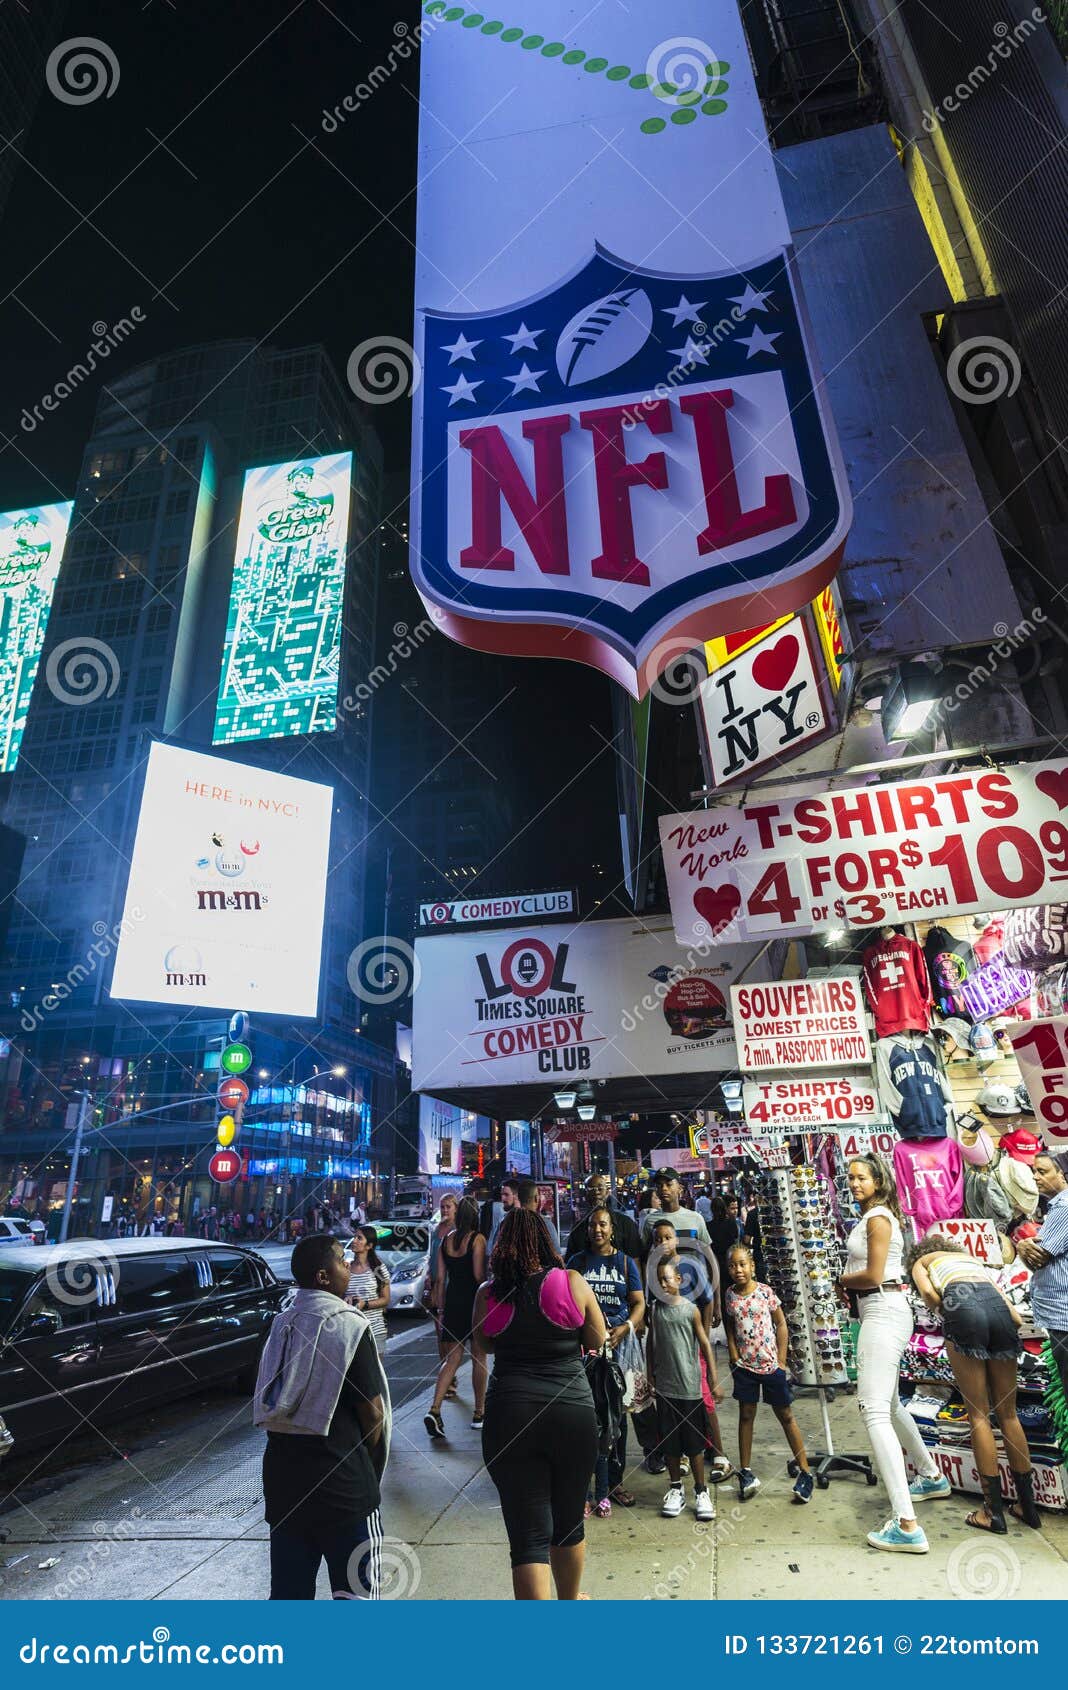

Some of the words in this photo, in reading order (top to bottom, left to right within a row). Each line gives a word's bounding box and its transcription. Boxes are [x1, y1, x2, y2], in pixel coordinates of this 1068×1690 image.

[459, 388, 798, 587] NFL
[262, 503, 332, 526] Green
[268, 518, 334, 542] Giant
[716, 670, 744, 724] I
[717, 680, 808, 776] NY
[184, 780, 233, 803] HERE
[239, 793, 253, 808] in
[258, 798, 299, 818] NYC!
[744, 773, 1019, 850] T-SHIRTS
[668, 822, 730, 850] New
[679, 836, 750, 882] York
[747, 861, 802, 924] 4
[806, 848, 906, 897] FOR
[422, 902, 456, 926] LOL
[811, 904, 828, 921] or
[896, 887, 949, 911] EACH
[476, 937, 577, 1001] LOL
[738, 980, 857, 1020] SOUVENIRS
[483, 1016, 585, 1057] COMEDY
[745, 1020, 802, 1038] LOWEST
[805, 1015, 858, 1033] PRICES
[666, 1046, 682, 1055] BUY
[684, 1040, 715, 1051] TICKETS
[716, 1035, 737, 1045] HERE
[744, 1044, 752, 1066] 2
[753, 1043, 775, 1066] min.
[776, 1038, 828, 1064] PASSPORT
[830, 1036, 866, 1060] PHOTO
[538, 1046, 591, 1073] CLUB
[894, 1061, 915, 1084] NEW
[775, 1081, 853, 1099] SHIRTS
[749, 1101, 771, 1123] 4
[770, 1102, 813, 1117] FOR
[563, 1122, 619, 1133] BROADWAY
[576, 1132, 612, 1142] SHOWS
[761, 1147, 788, 1158] HATS
[913, 1169, 945, 1189] NY
[962, 1222, 988, 1233] NY
[1034, 1492, 1062, 1505] ACH
